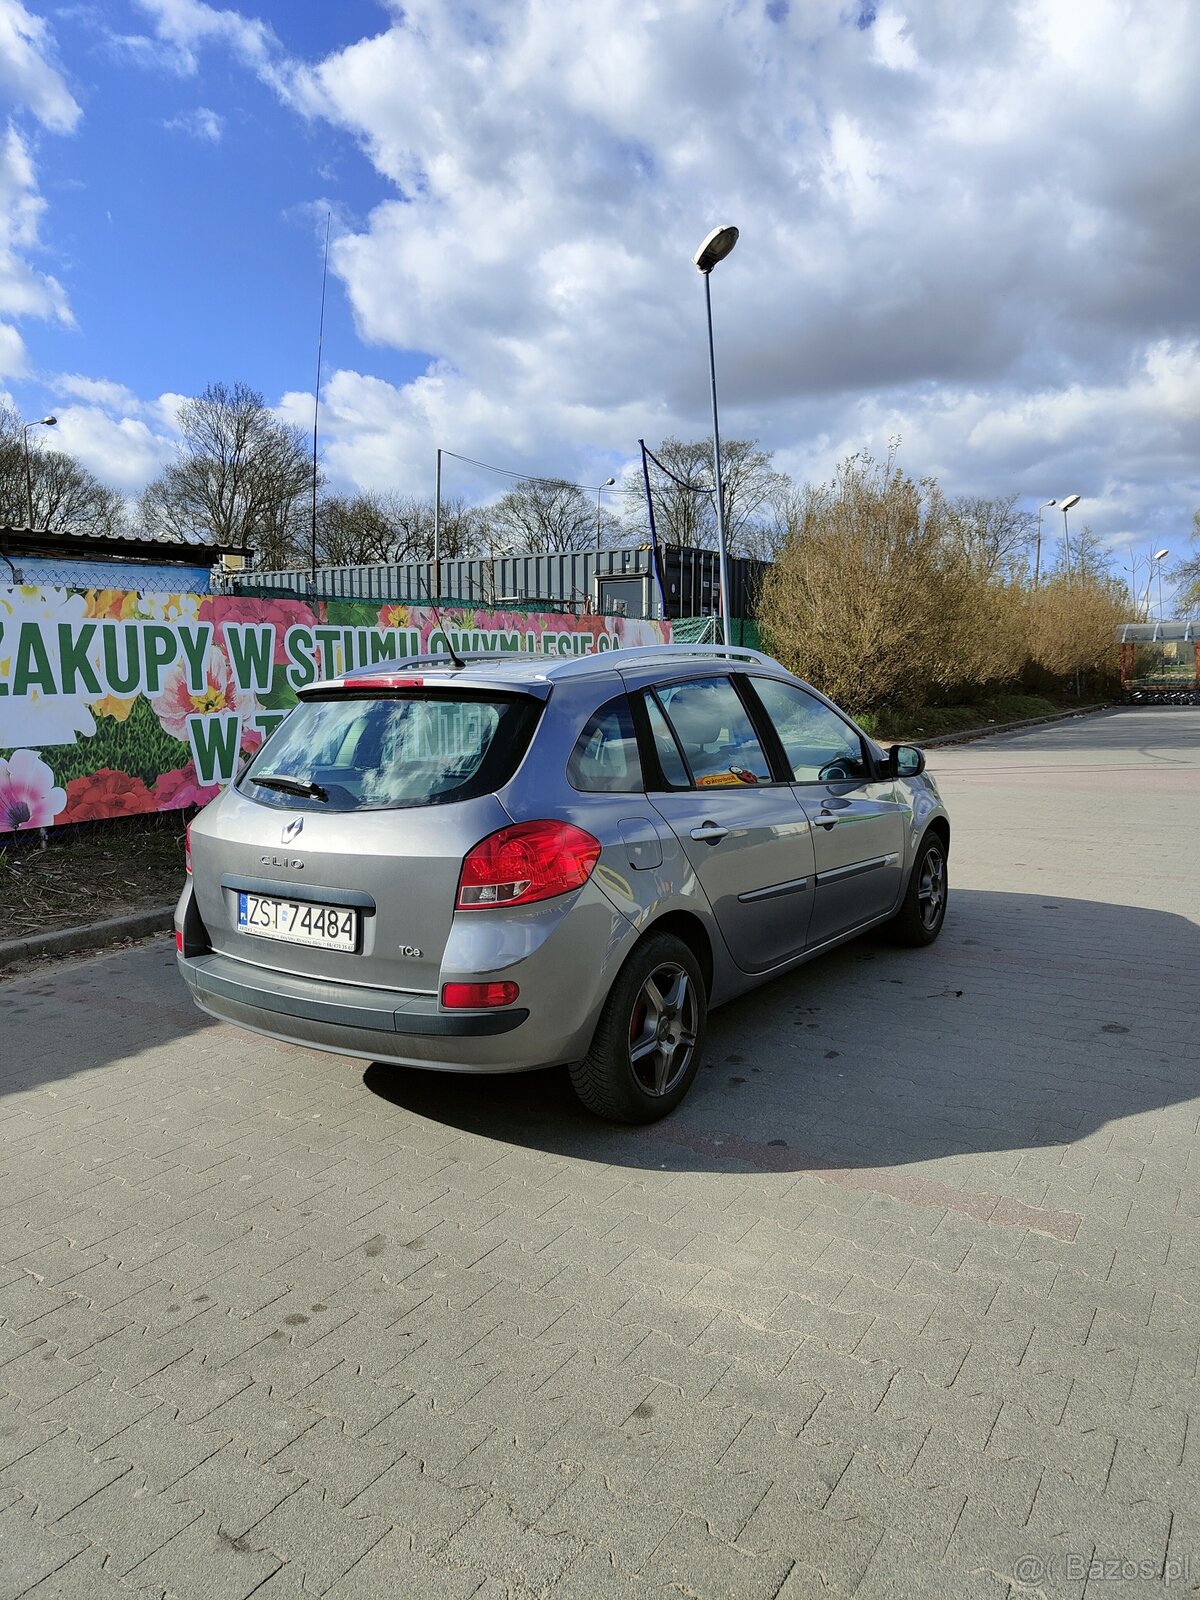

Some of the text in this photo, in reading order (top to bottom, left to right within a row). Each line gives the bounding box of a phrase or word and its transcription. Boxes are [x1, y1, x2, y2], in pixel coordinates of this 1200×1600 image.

[0, 622, 210, 696] AKUPY
[227, 627, 272, 690] W
[190, 716, 238, 781] W
[260, 855, 305, 870] CLIO
[249, 897, 282, 929] ZST
[288, 903, 354, 942] 74484
[398, 944, 421, 957] TCe
